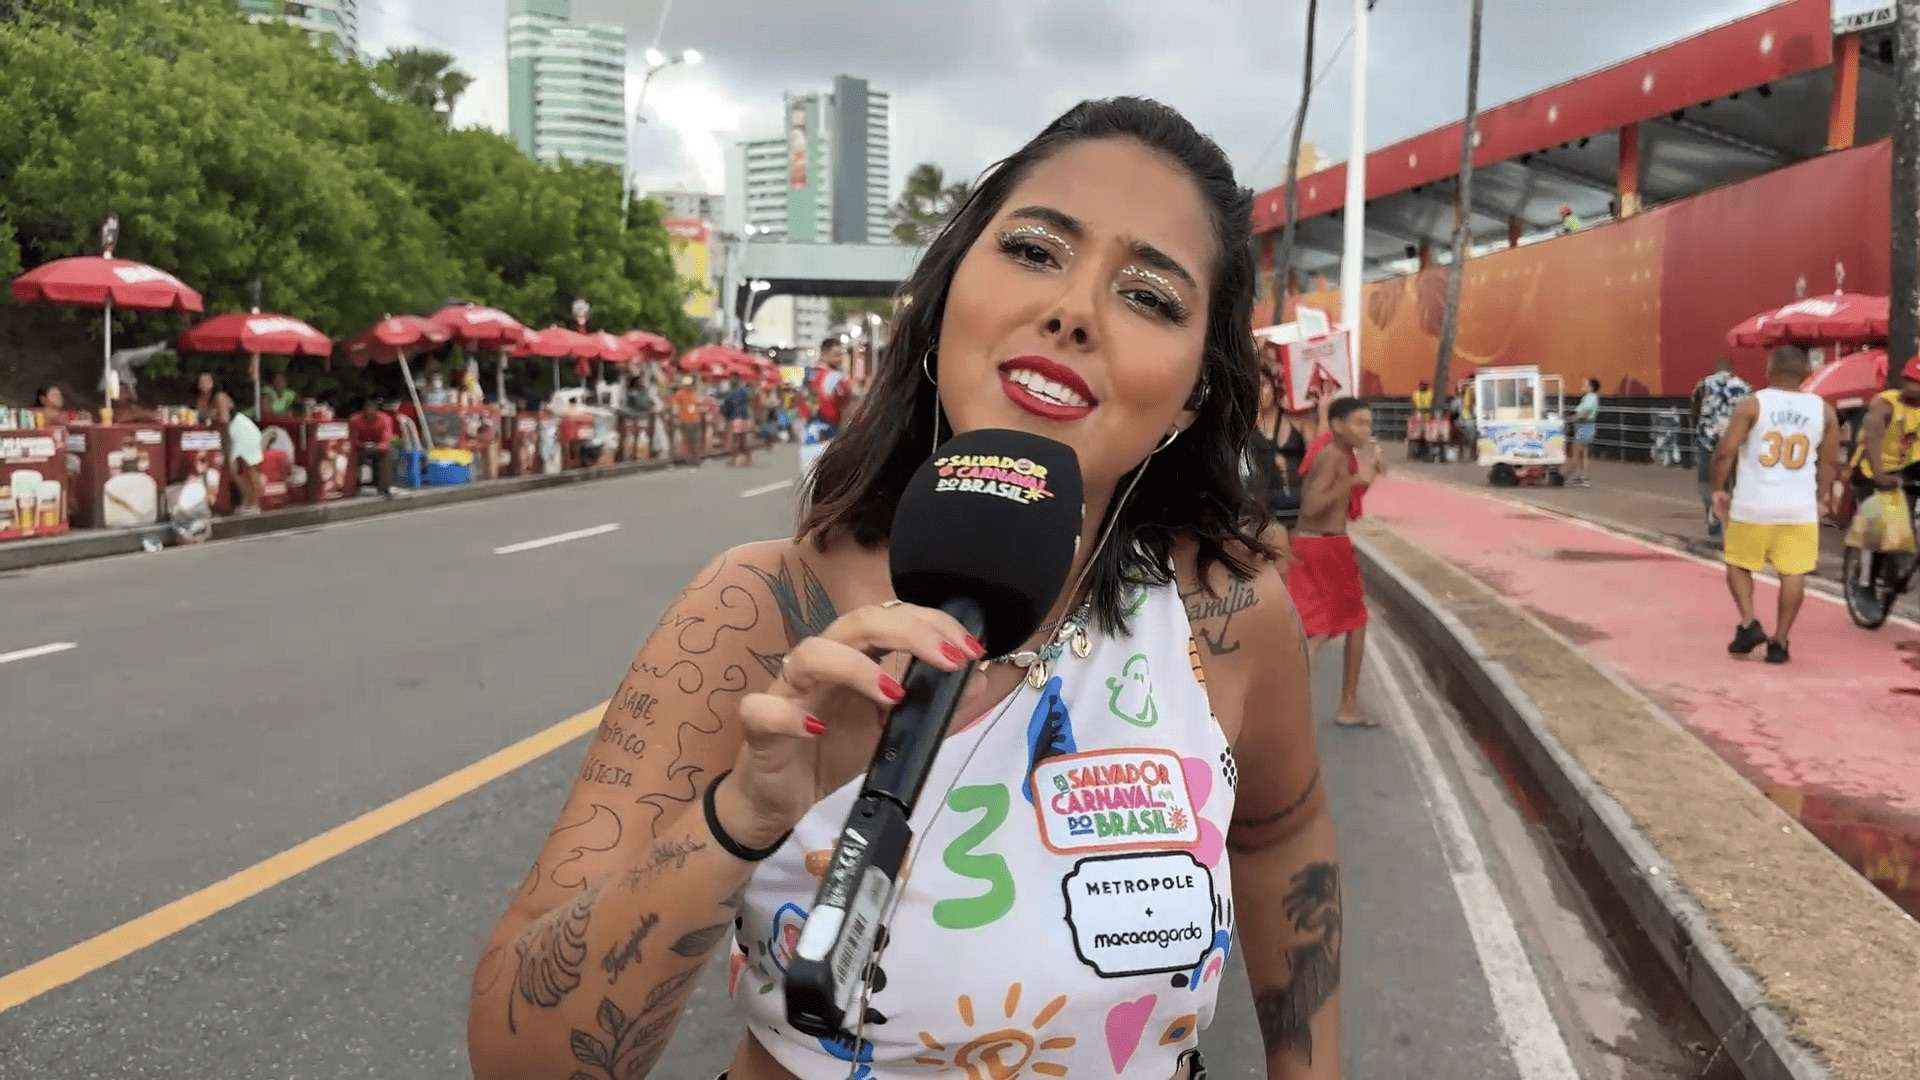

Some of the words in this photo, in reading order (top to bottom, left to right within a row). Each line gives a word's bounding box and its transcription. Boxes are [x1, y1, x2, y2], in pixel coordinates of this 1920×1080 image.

[1769, 408, 1811, 428] CURRY
[1759, 431, 1809, 470] 30
[949, 455, 1048, 479] SALVADOR
[935, 478, 959, 492] DO
[958, 478, 1030, 504] BRASIL
[956, 466, 1055, 497] CARNAVAL
[1067, 761, 1171, 789] SALVADOR
[1051, 785, 1167, 815] CARNAVAL
[1067, 815, 1094, 836] DO
[1094, 809, 1179, 838] BRASIL
[1086, 875, 1195, 896] METROPOLE
[1095, 922, 1202, 949] macacogordo
